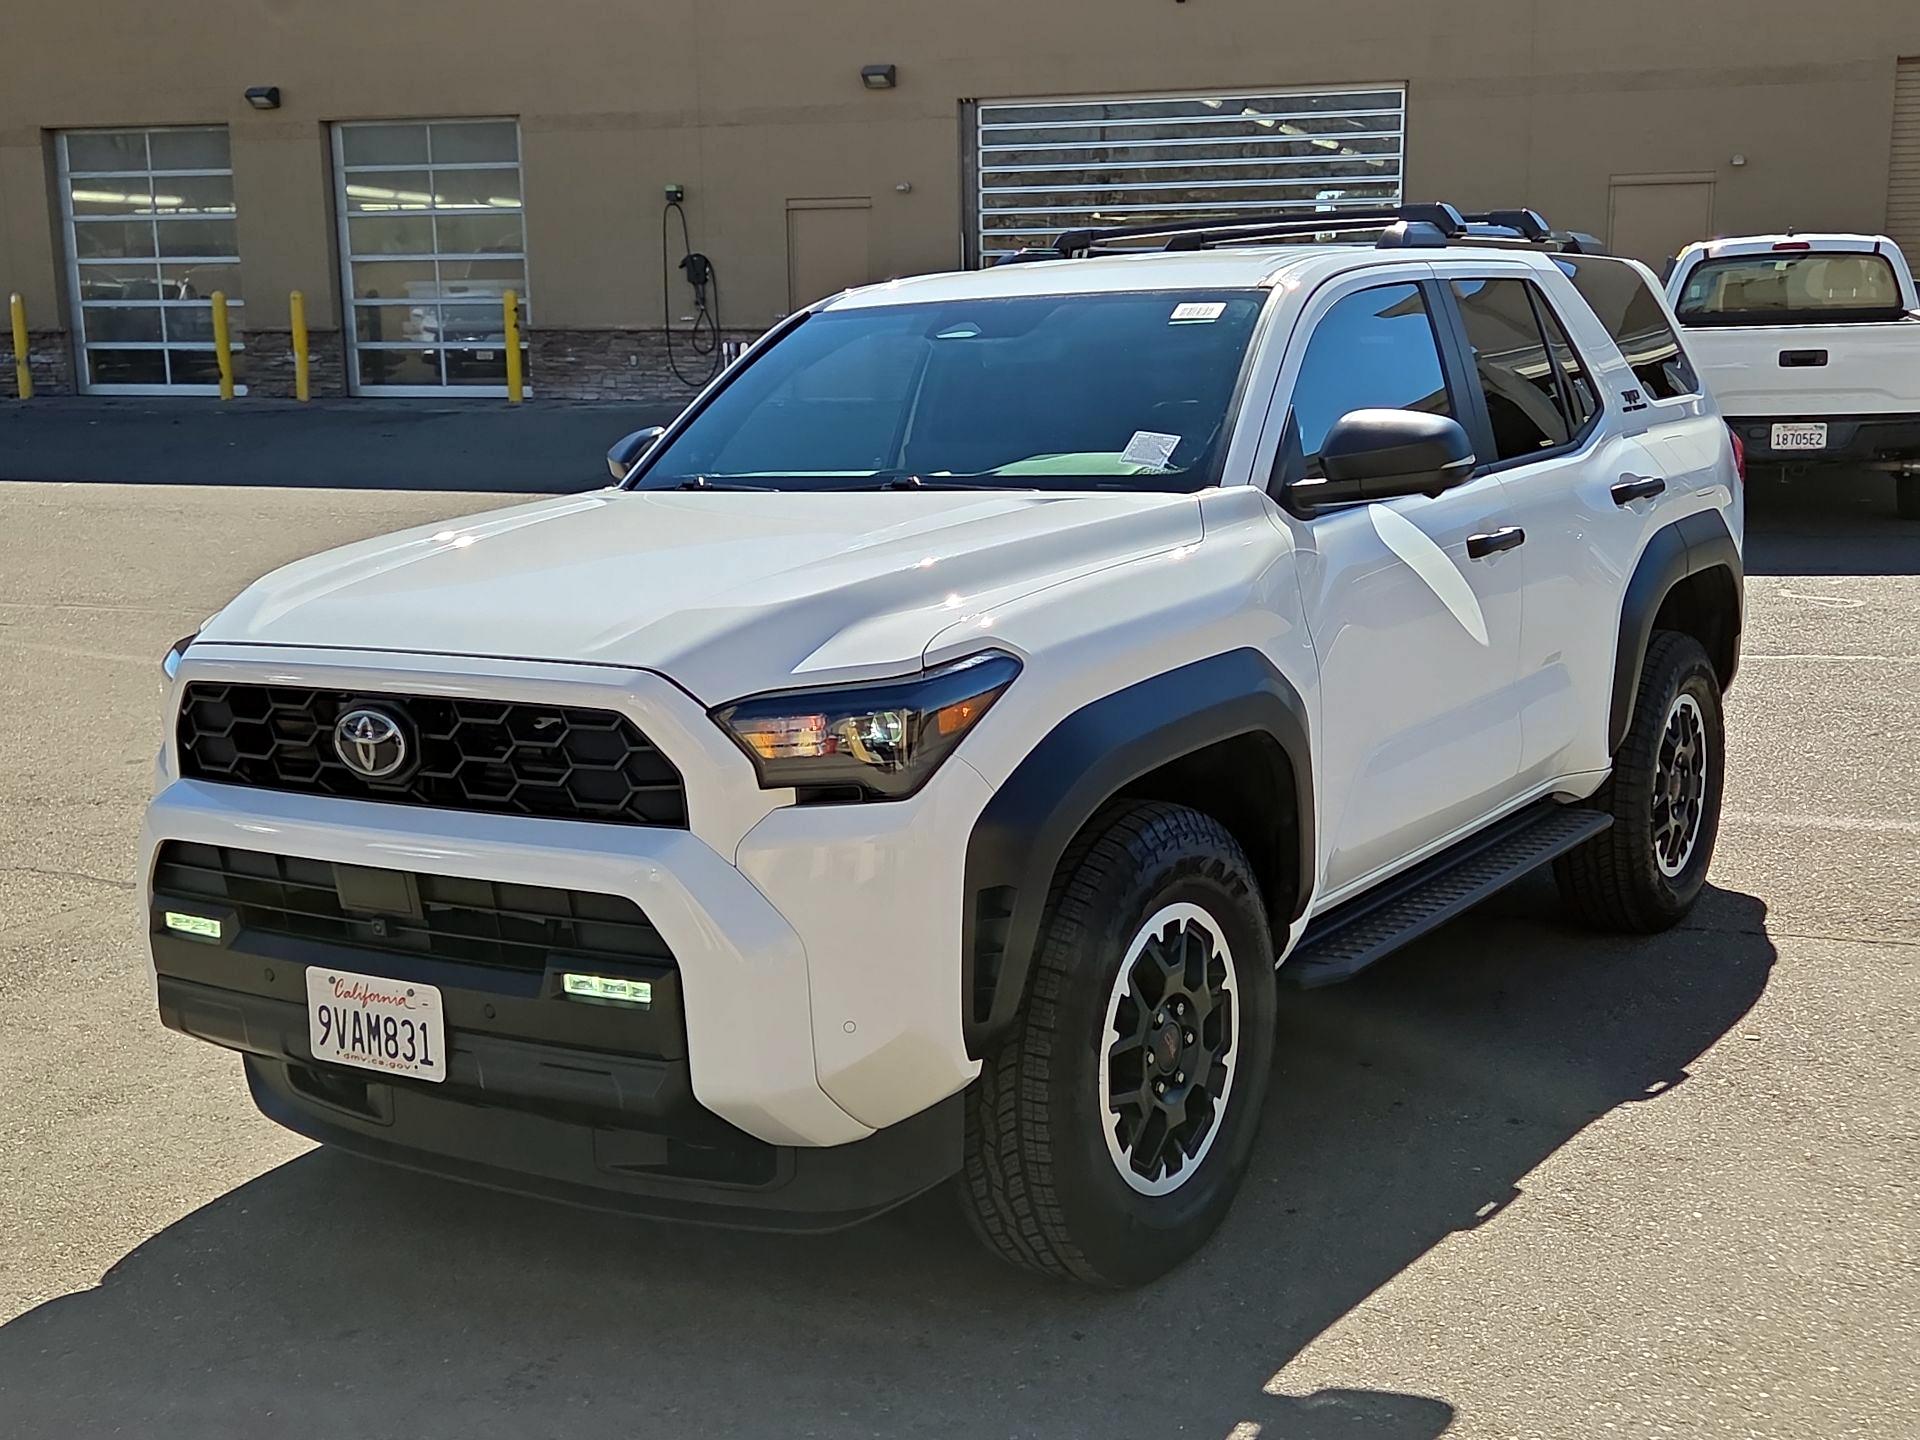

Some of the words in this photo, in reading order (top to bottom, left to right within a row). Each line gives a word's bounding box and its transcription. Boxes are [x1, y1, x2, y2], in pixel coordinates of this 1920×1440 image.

[1775, 433, 1823, 446] 18705E2
[334, 978, 416, 1009] California
[318, 1005, 434, 1067] 9VAM831
[343, 1052, 411, 1070] dmv.ca.gov
